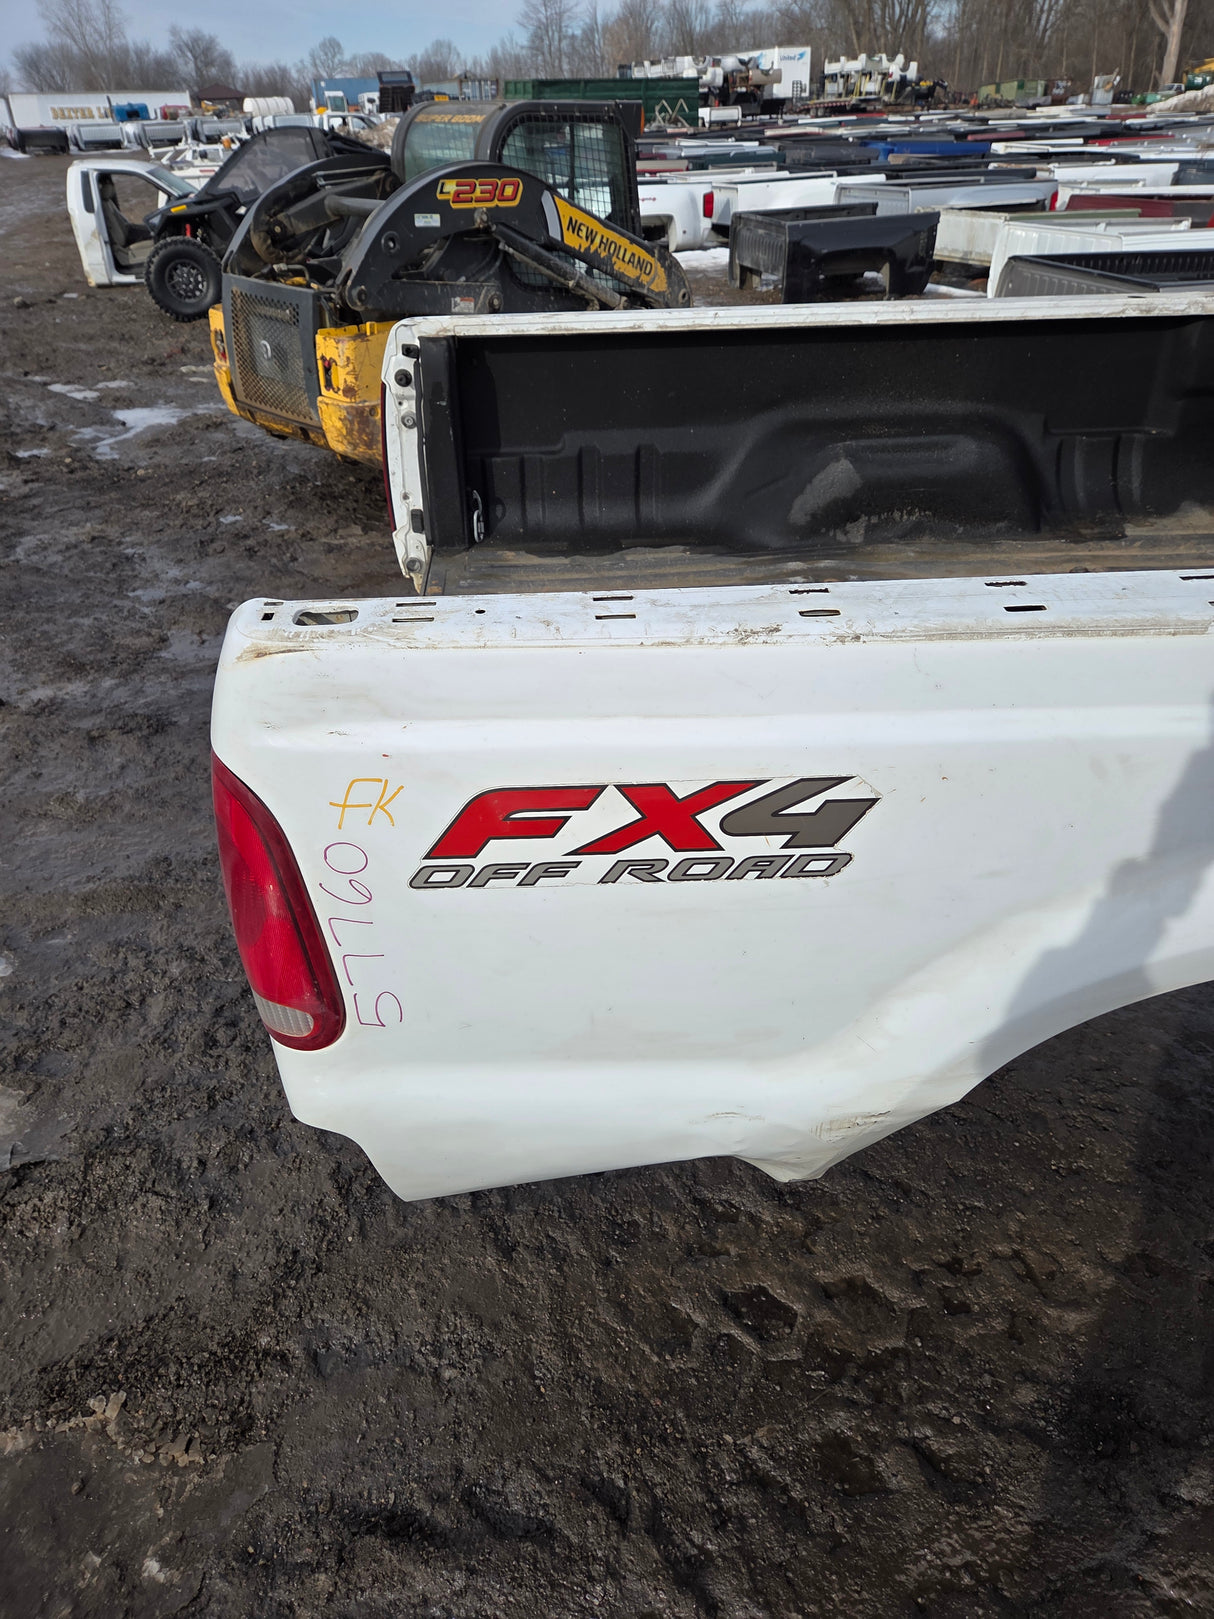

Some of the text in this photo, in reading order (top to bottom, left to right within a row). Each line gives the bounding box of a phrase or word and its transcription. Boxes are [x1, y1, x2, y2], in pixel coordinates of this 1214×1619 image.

[437, 178, 523, 207] L230
[566, 215, 653, 276] NEW HOLLAND
[422, 775, 882, 860] FX4
[409, 852, 855, 889] OFF ROAD
